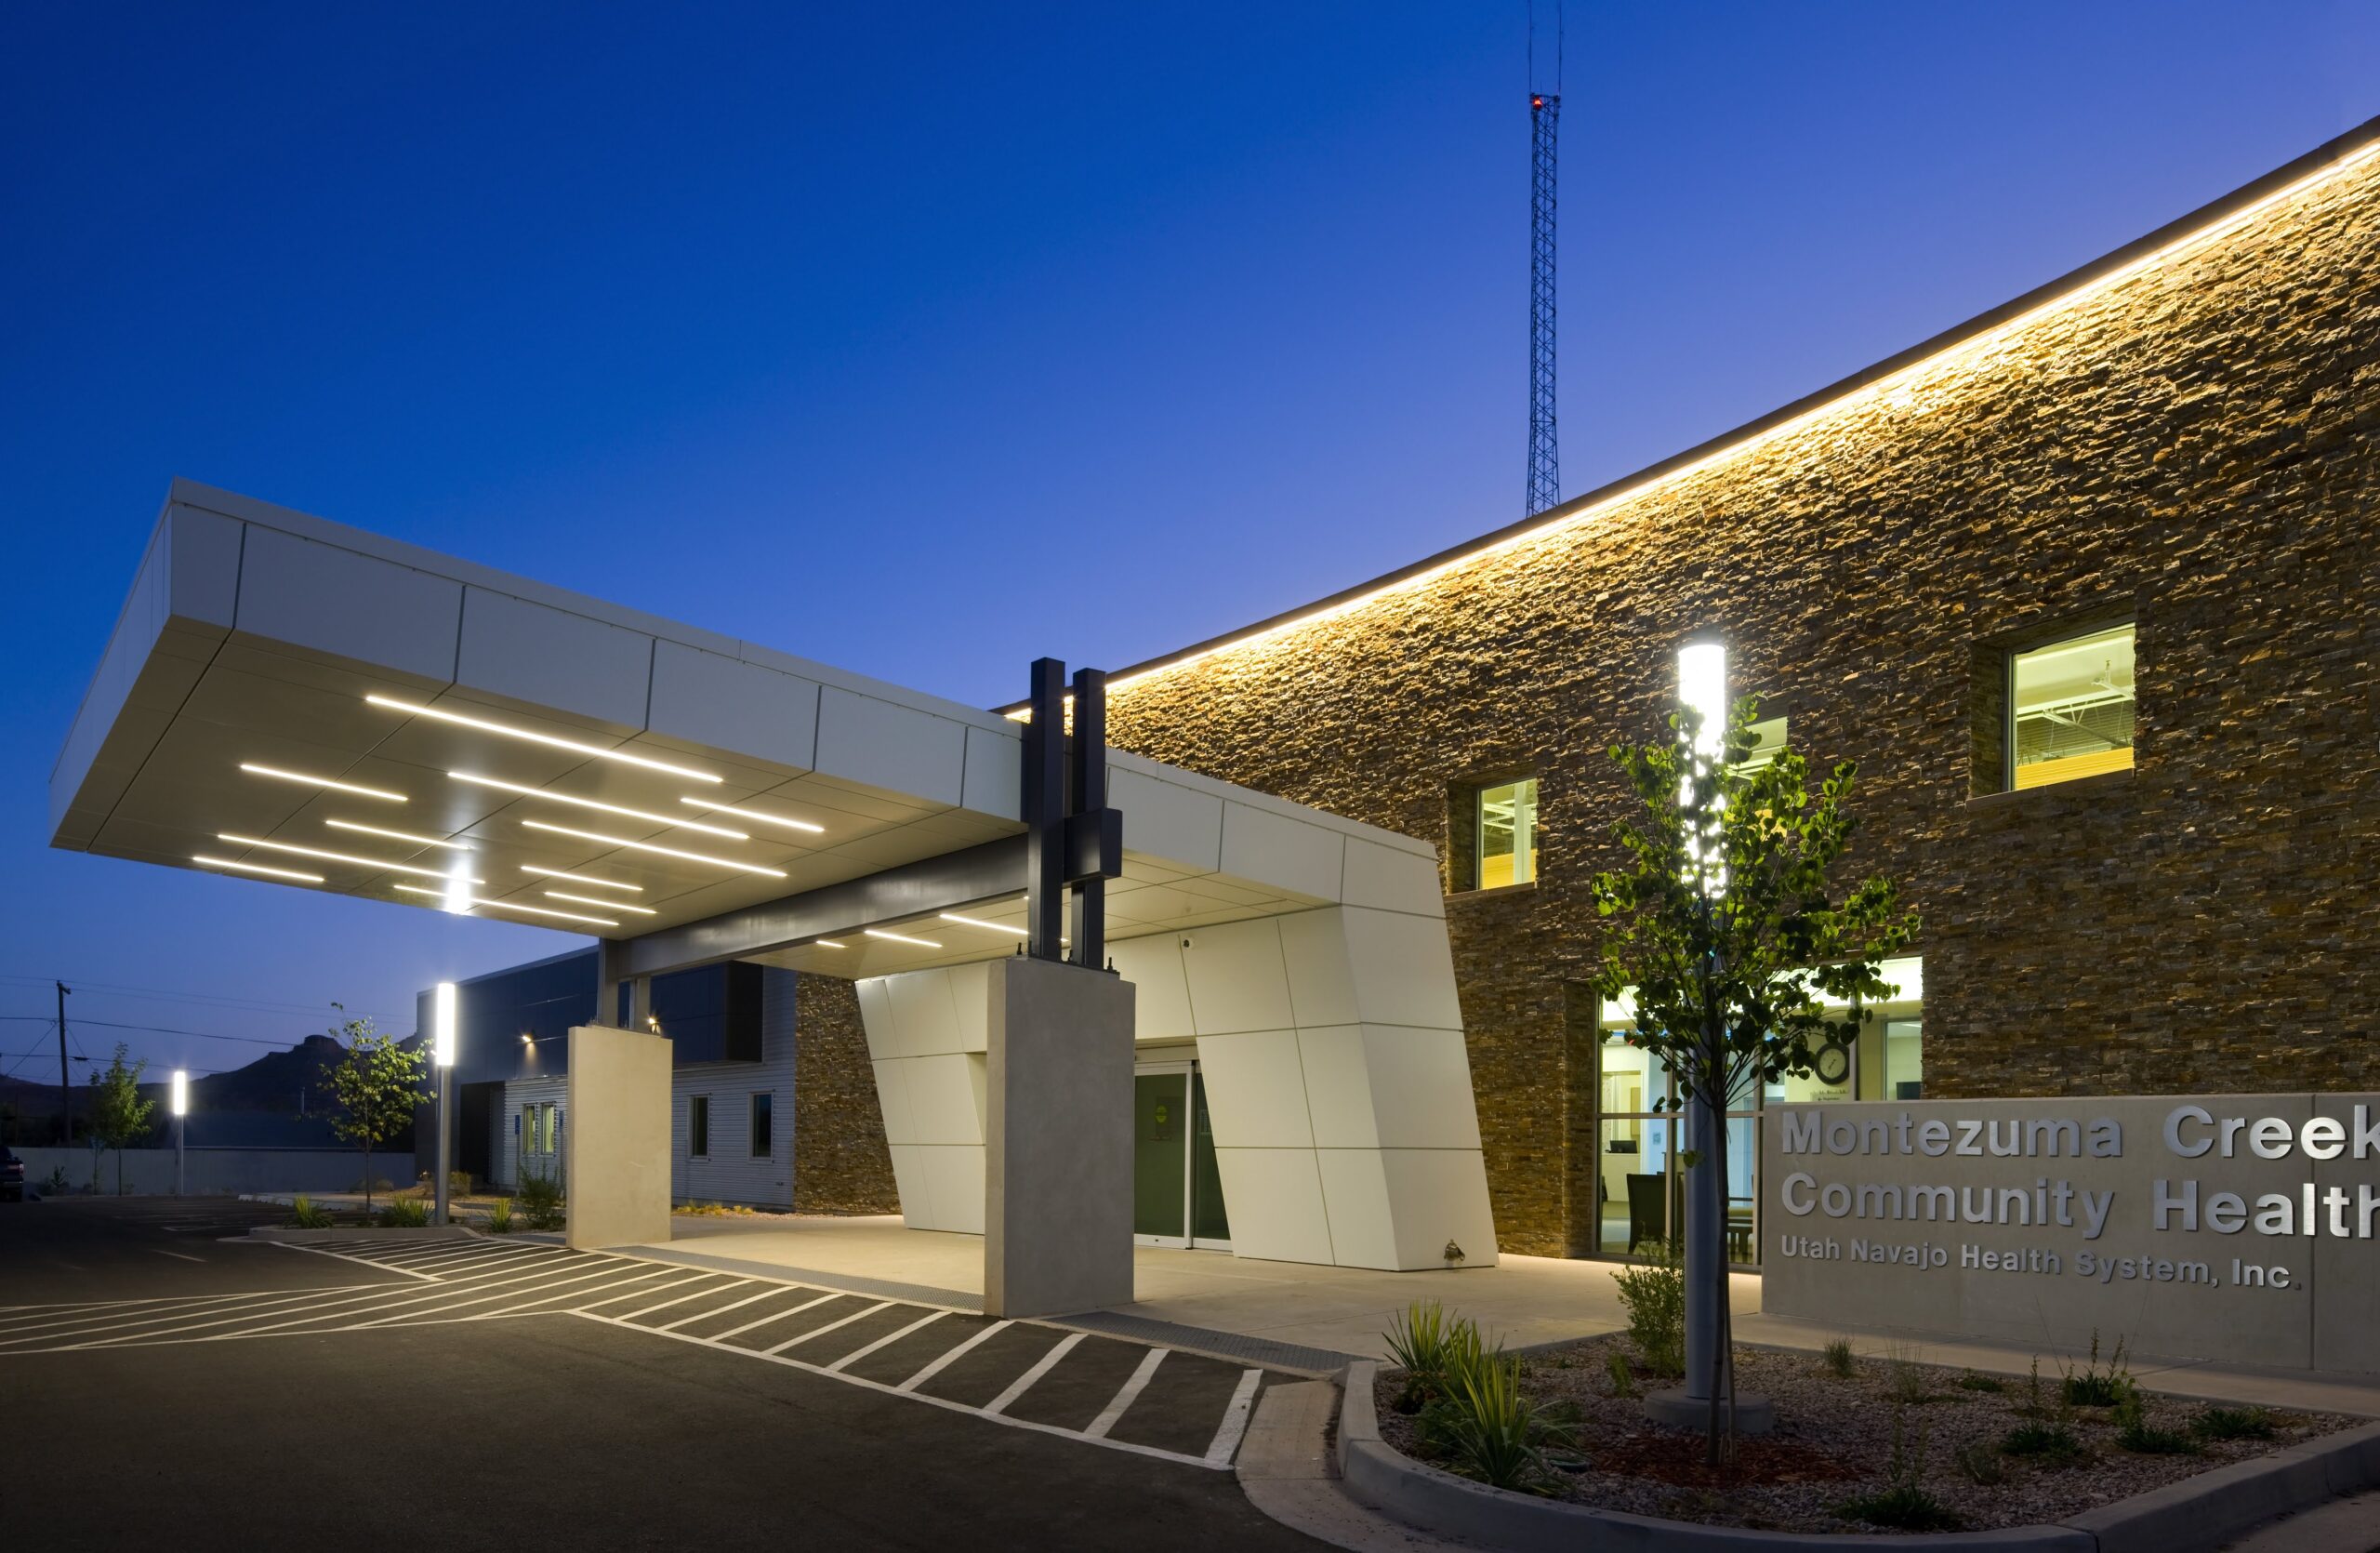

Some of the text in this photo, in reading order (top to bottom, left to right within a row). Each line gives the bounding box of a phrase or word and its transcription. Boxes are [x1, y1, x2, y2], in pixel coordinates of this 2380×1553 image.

[1781, 1105, 2380, 1160] Montezuma Creek
[1781, 1172, 2115, 1239] Community
[1781, 1234, 2302, 1291] Utah Navajo Health System, Inc.
